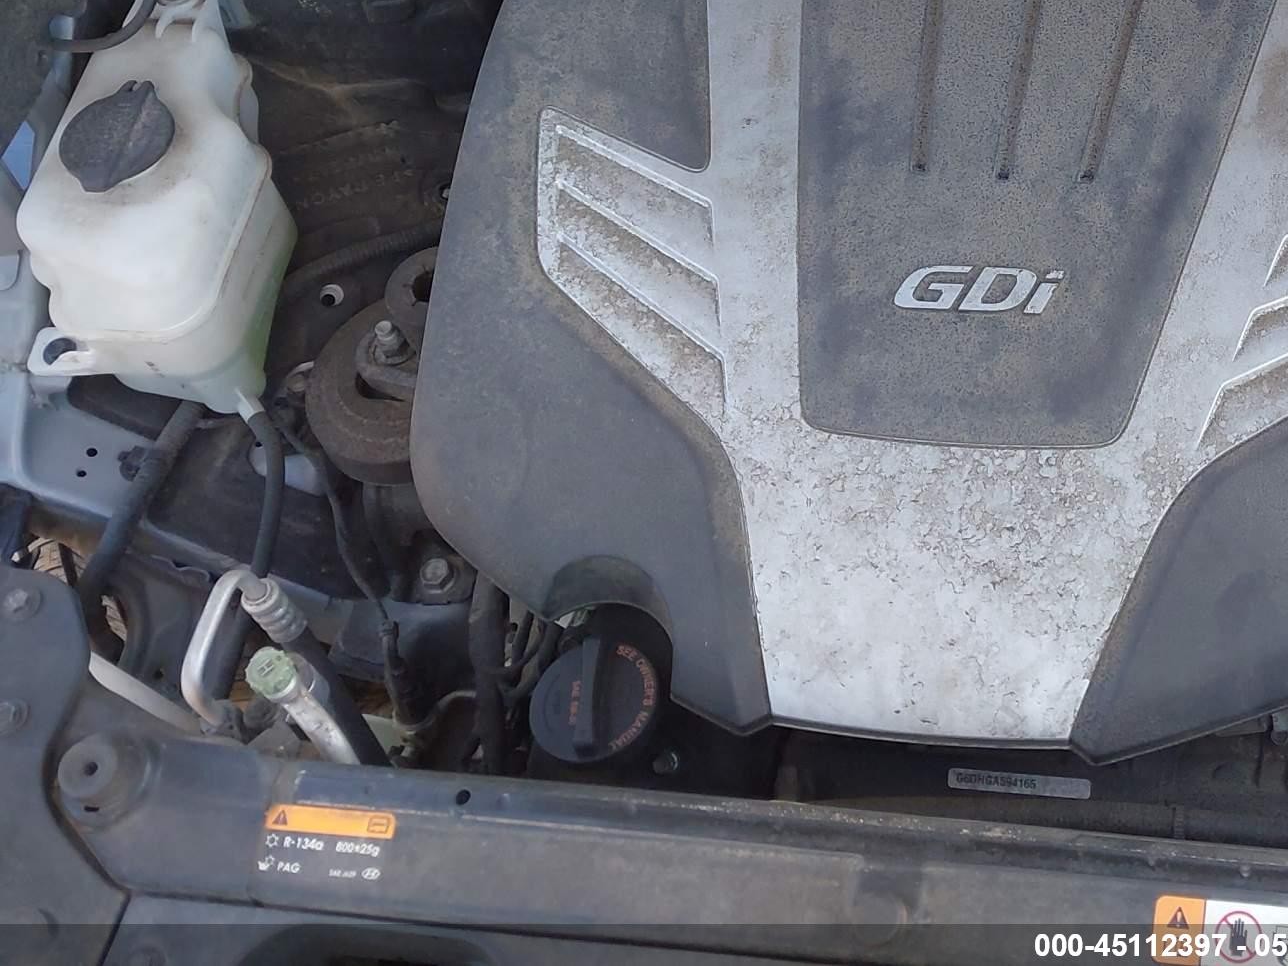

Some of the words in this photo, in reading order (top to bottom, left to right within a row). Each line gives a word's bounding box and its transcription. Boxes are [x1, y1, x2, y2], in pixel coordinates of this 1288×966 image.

[894, 265, 1065, 314] GDi
[616, 644, 637, 661] SEE
[608, 711, 649, 752] MANUAL
[283, 836, 324, 851] R-134a
[277, 861, 301, 873] PAG
